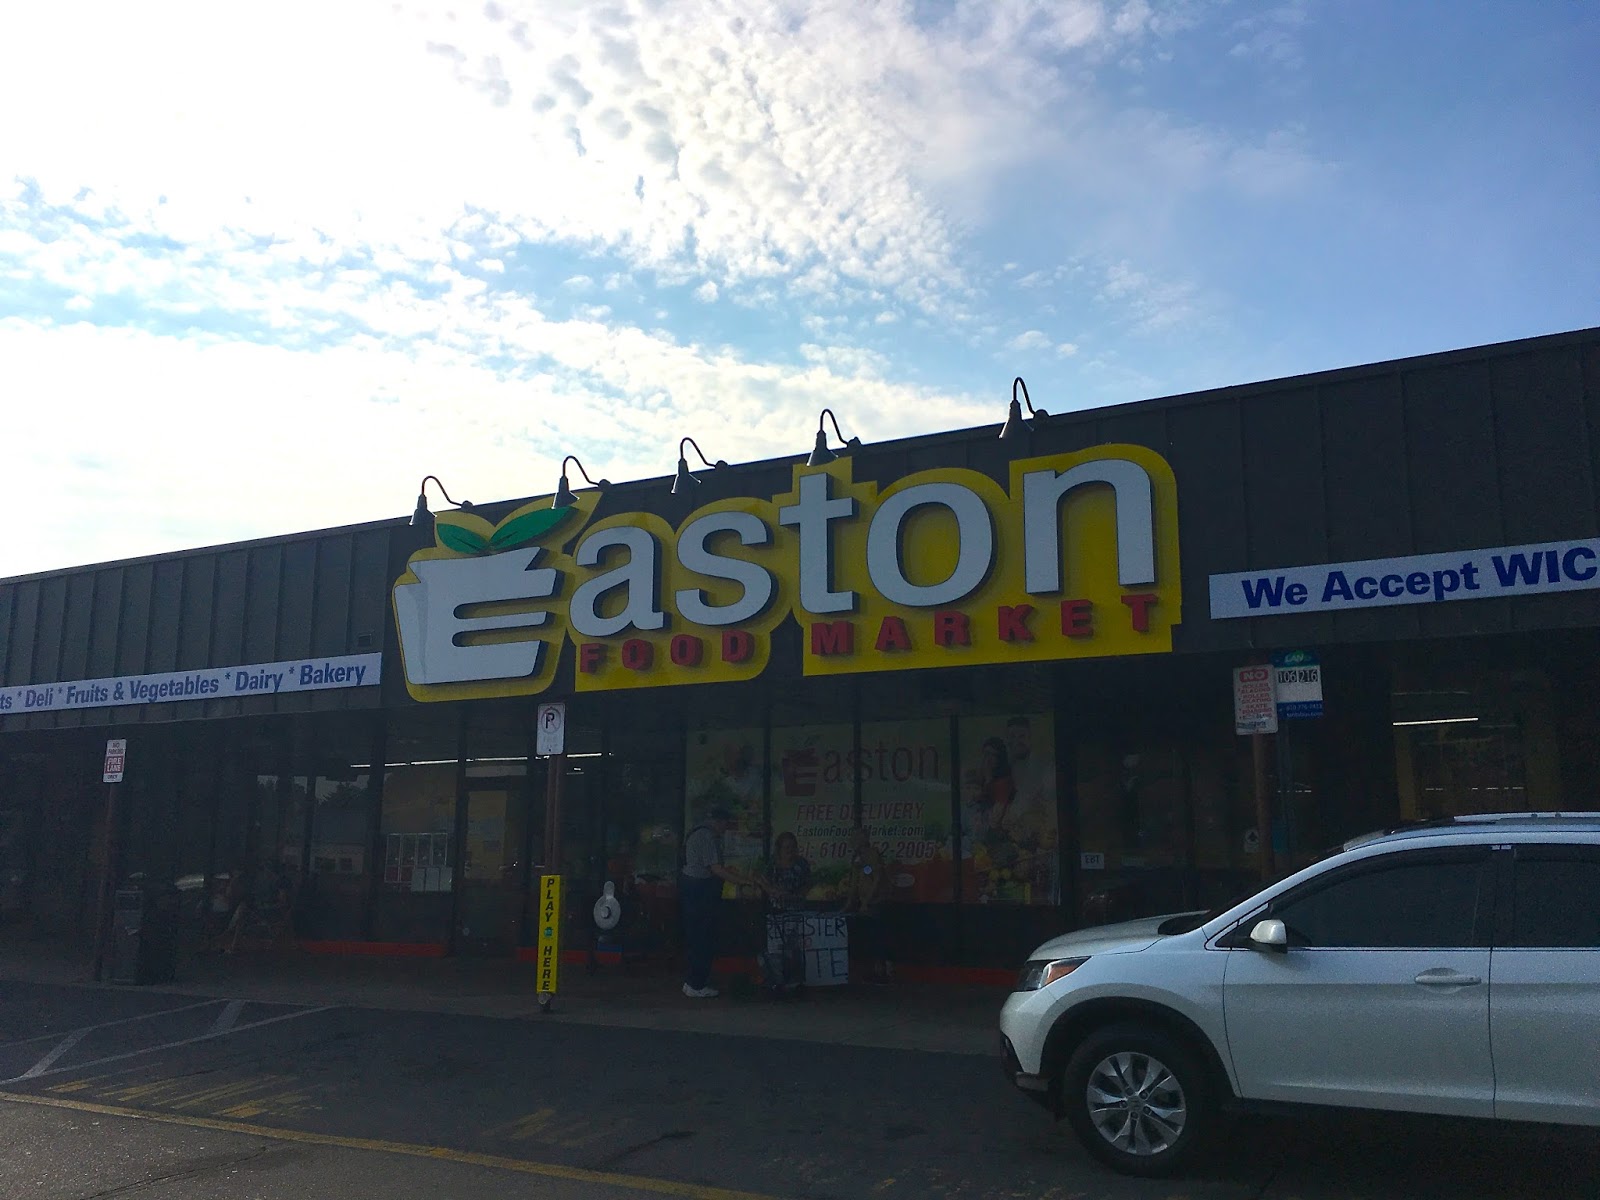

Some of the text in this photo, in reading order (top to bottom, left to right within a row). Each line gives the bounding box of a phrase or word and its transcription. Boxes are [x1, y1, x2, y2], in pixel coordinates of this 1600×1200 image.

[394, 458, 1156, 685] Easton
[1241, 546, 1598, 609] We Accept WIC
[579, 594, 1159, 674] FOOD MARKET
[25, 688, 53, 708] Deli
[66, 682, 108, 705] Fruits
[113, 680, 125, 701] &
[129, 675, 219, 702] Vegetables
[235, 668, 283, 693] Dairy
[300, 662, 367, 687] Bakery
[1244, 671, 1266, 681] NO
[1279, 669, 1319, 683] 106 216
[106, 764, 121, 772] LANE
[107, 757, 122, 765] FIRE
[782, 740, 939, 797] Easton
[796, 804, 834, 821] FREE
[541, 878, 555, 992] PLAY HERE
